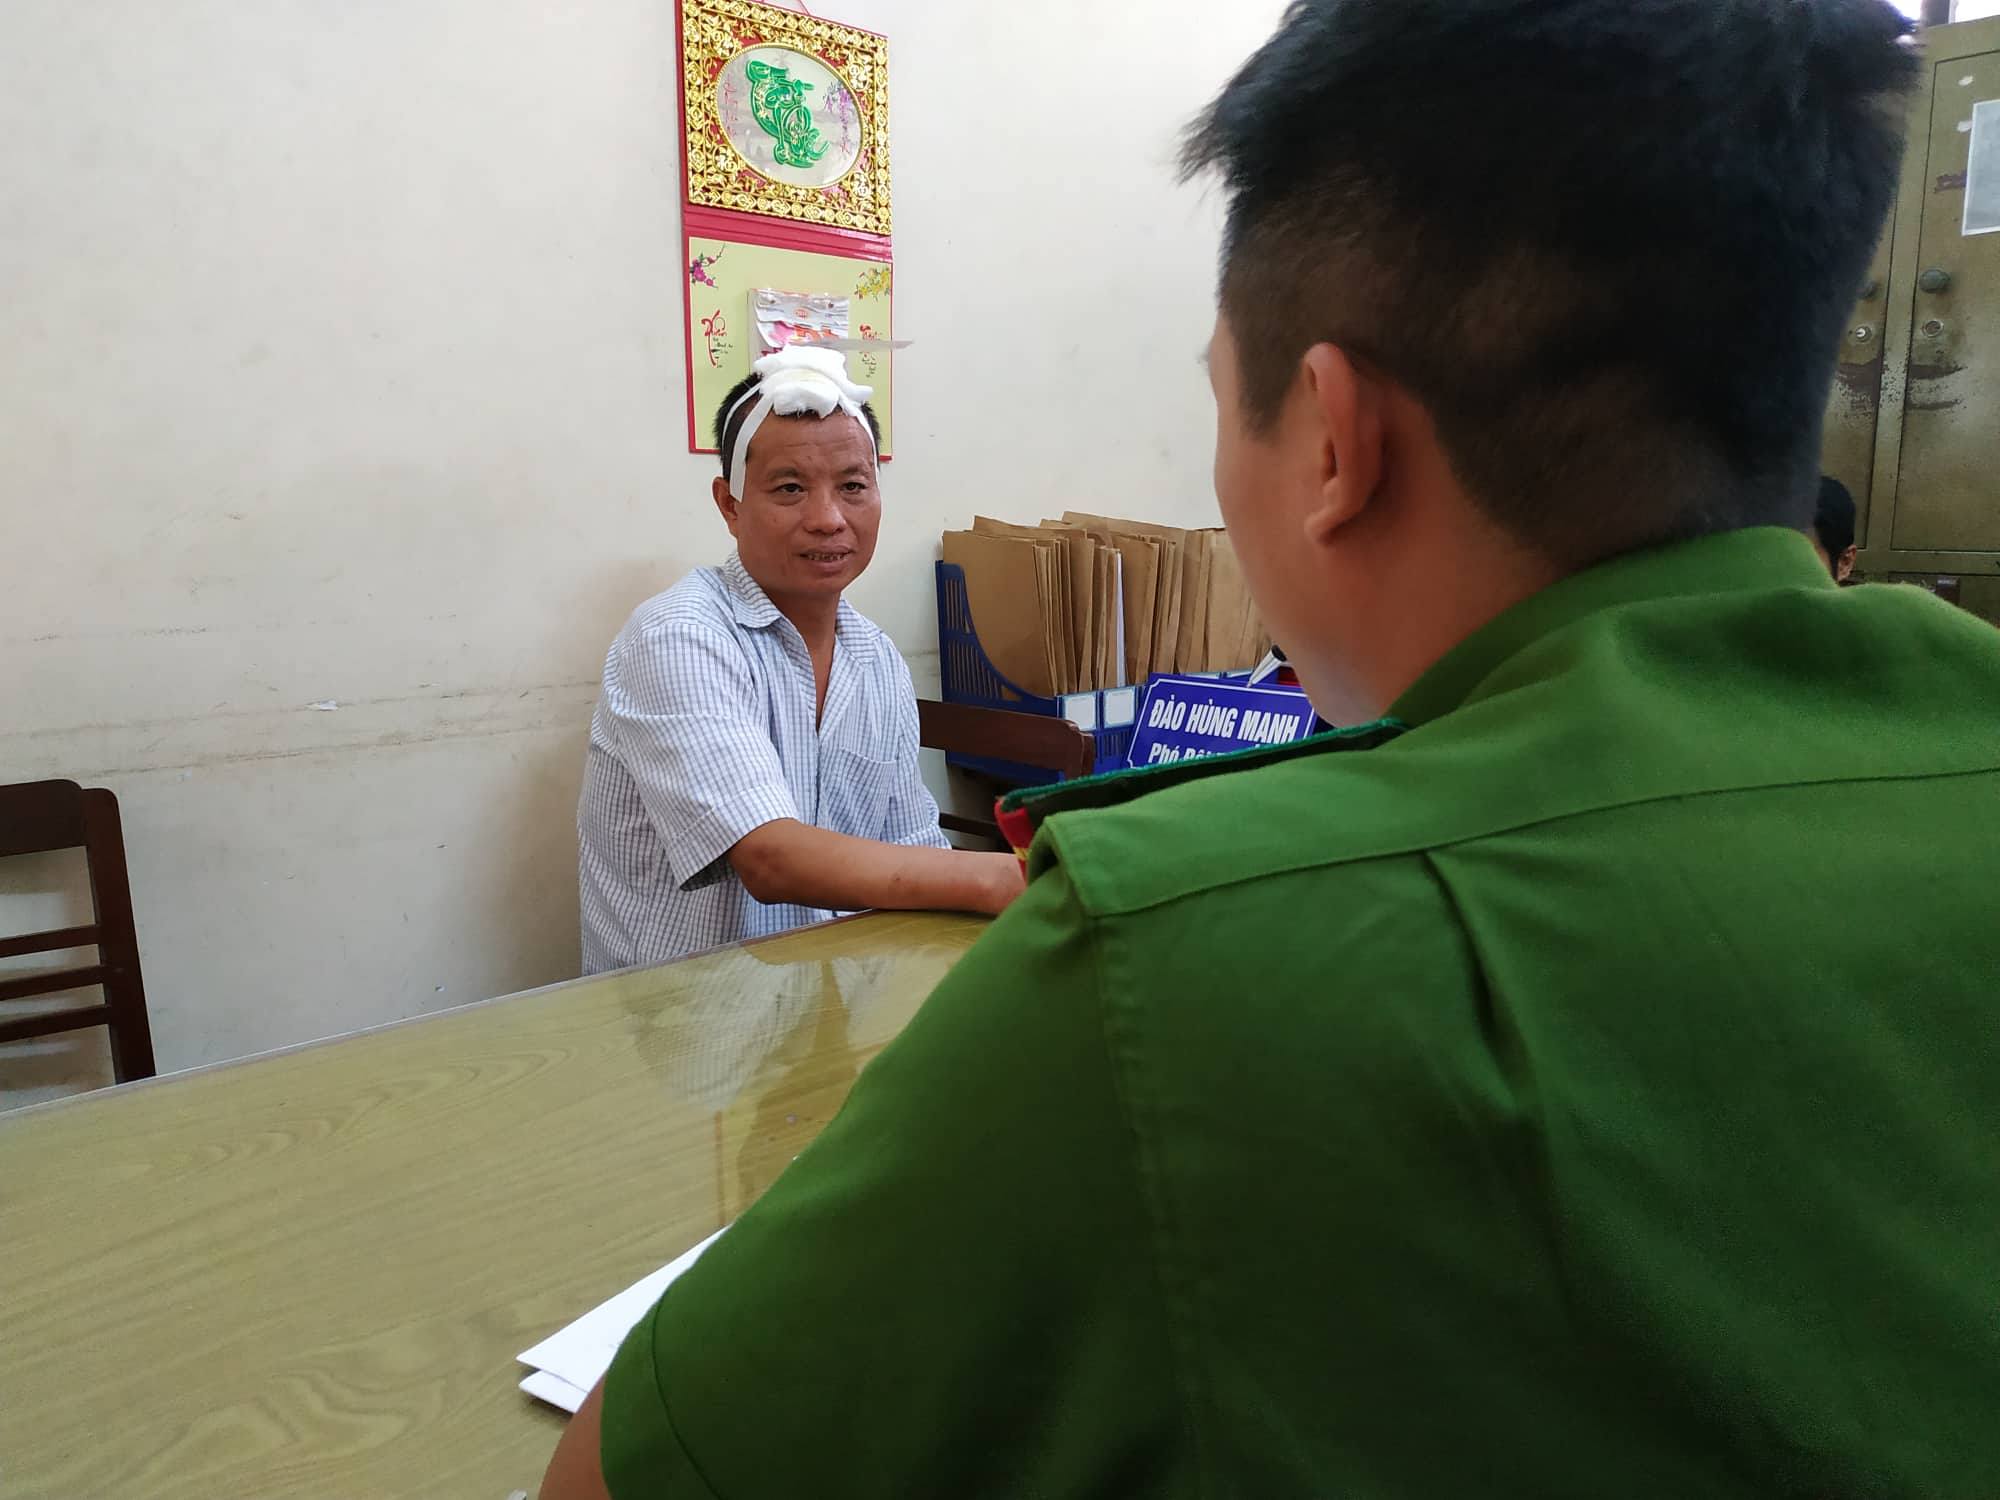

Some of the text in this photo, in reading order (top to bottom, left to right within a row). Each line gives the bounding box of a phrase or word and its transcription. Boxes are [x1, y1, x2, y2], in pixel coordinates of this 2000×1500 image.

[1148, 694, 1187, 731] ĐÀO
[1185, 699, 1238, 738] HÙNG
[1148, 743, 1180, 764] Phó
